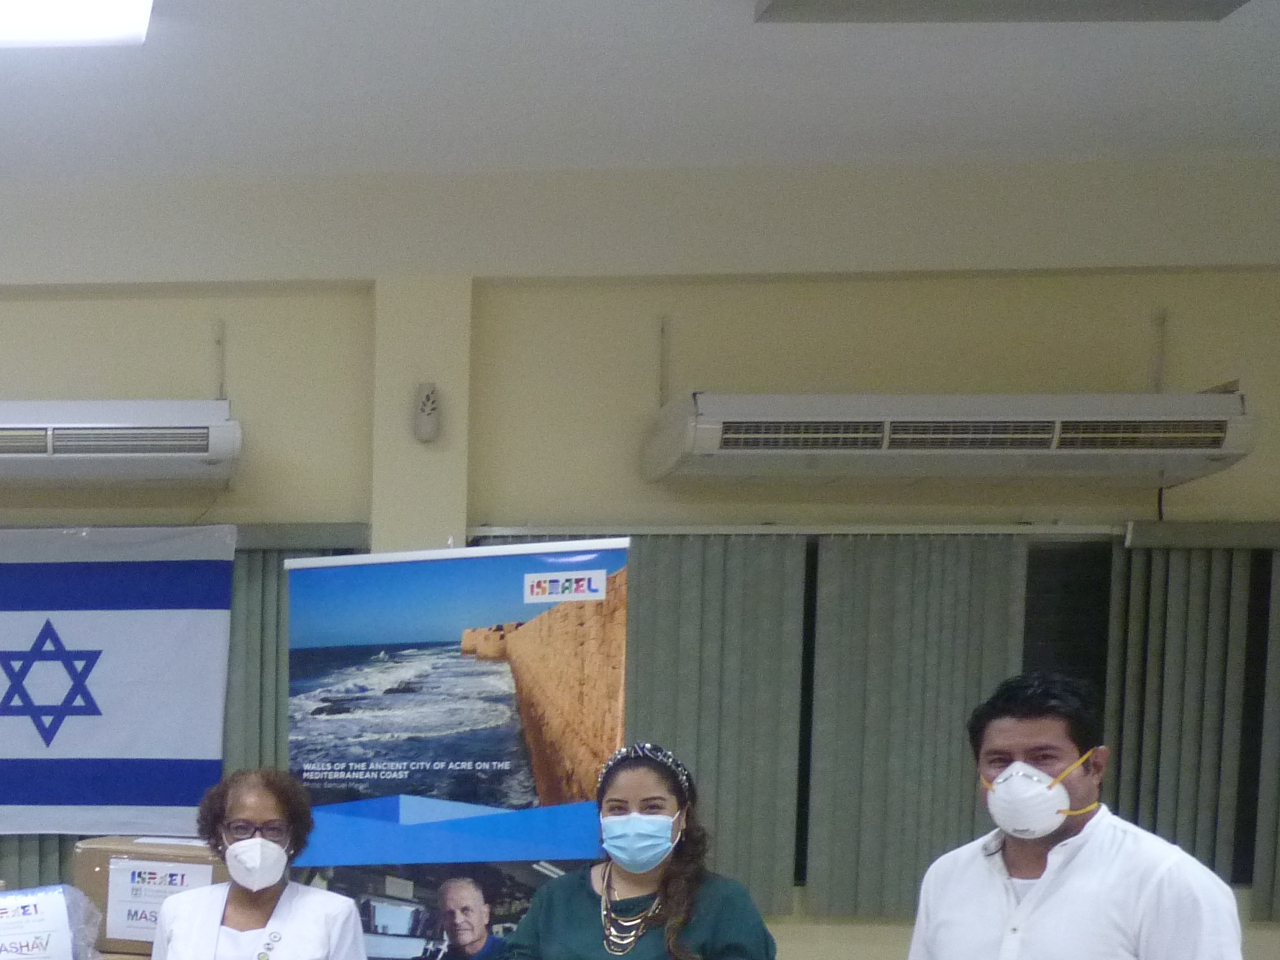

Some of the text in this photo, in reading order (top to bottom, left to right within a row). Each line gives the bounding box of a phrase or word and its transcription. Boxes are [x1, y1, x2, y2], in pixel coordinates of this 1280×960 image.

[302, 761, 511, 771] WALLS OF THE ANCIENT CITY OF ACRE ON THE
[302, 770, 410, 780] MEDITERRANEAN COAST
[127, 908, 158, 923] MAS
